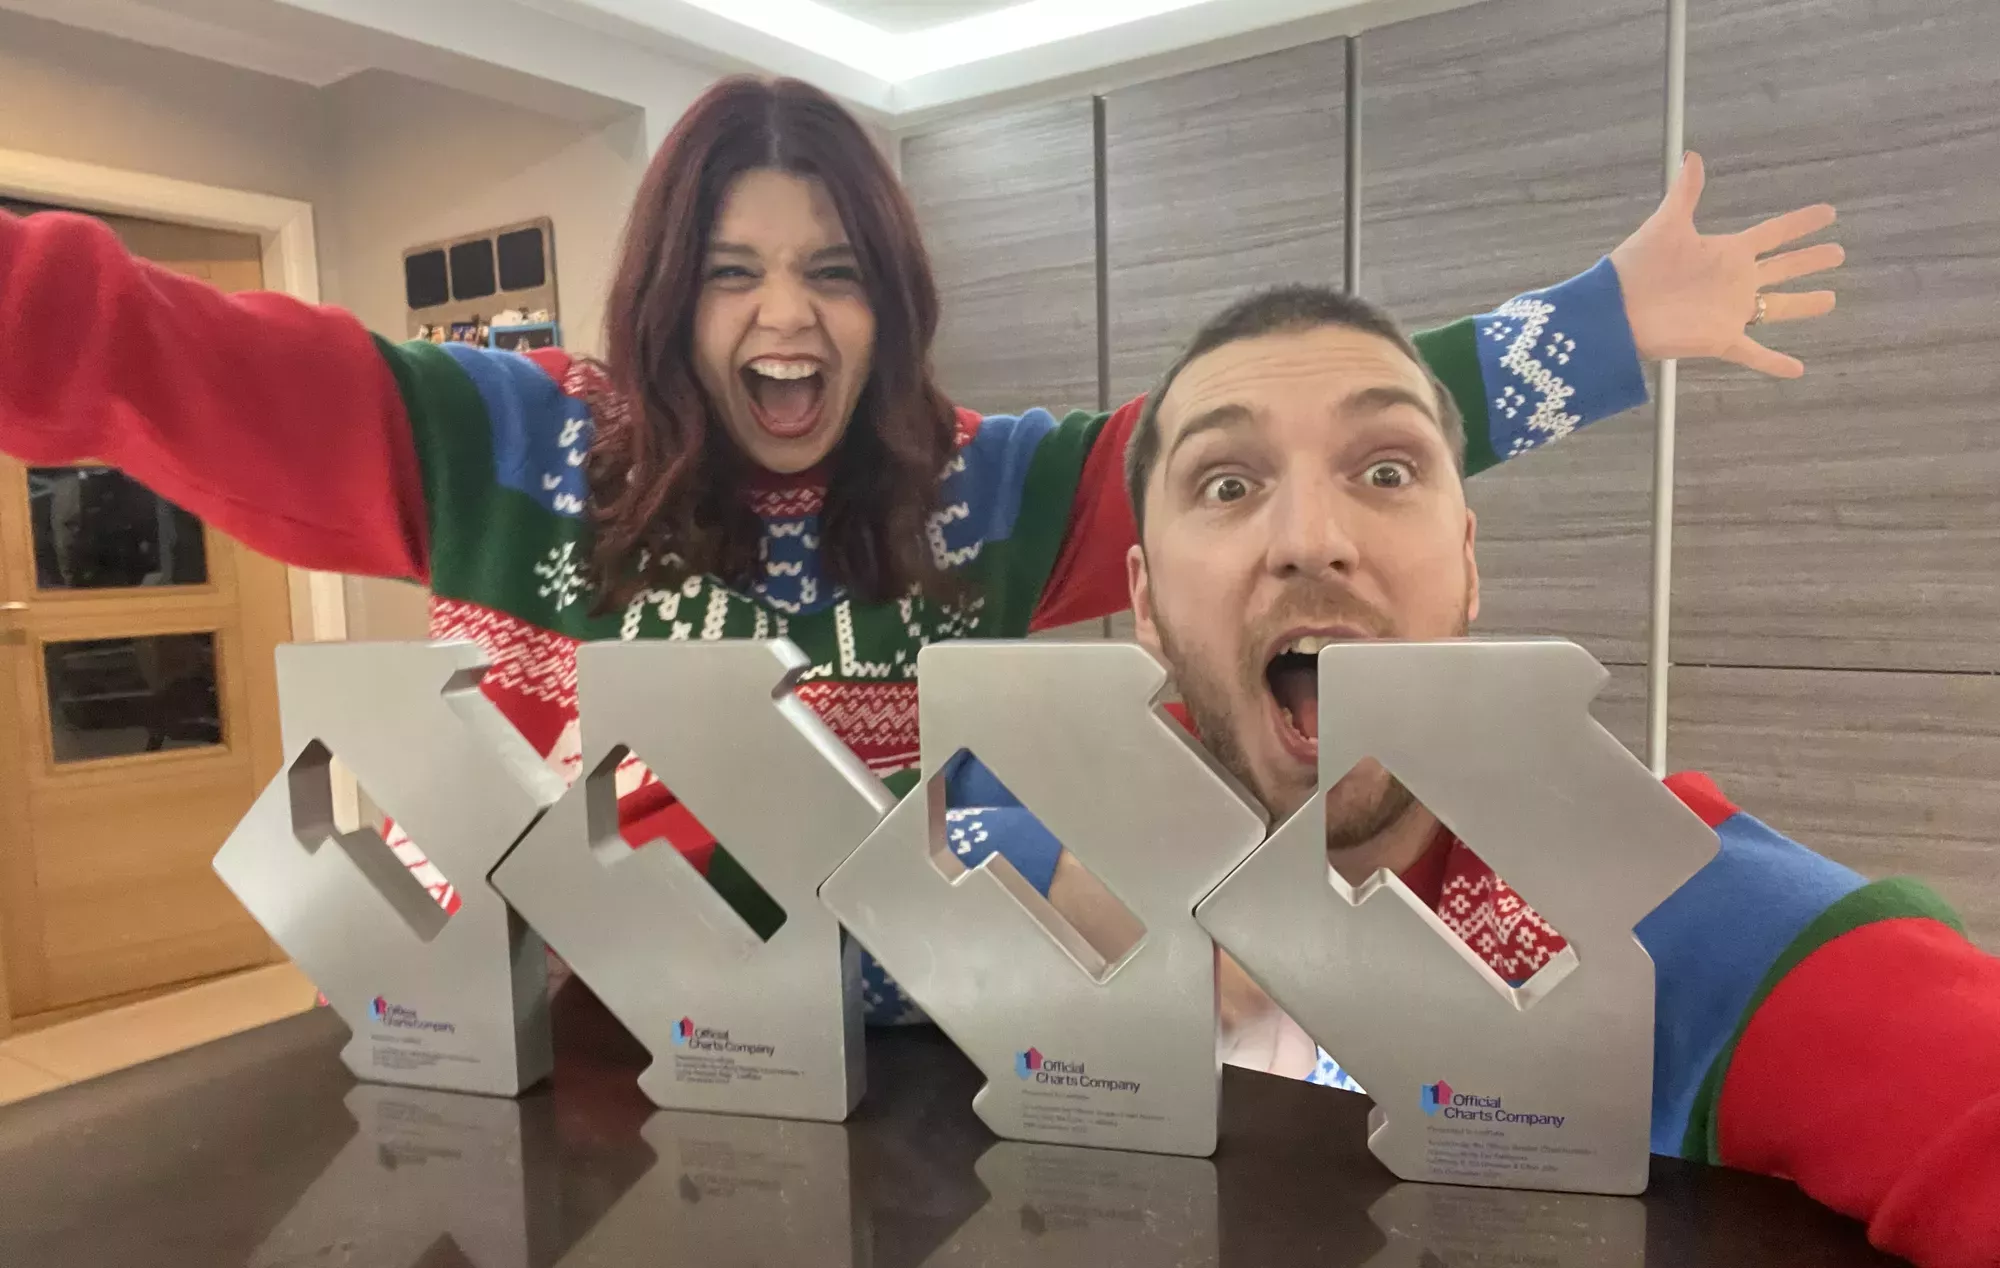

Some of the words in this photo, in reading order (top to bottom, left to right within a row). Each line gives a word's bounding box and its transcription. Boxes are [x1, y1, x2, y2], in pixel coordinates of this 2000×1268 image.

[724, 1041, 775, 1057] Company
[1043, 1060, 1085, 1075] Official
[1036, 1072, 1078, 1086] Charts
[1079, 1075, 1141, 1093] Company
[1453, 1094, 1502, 1108] Official
[1444, 1106, 1493, 1122] Charts
[1494, 1109, 1565, 1128] Company
